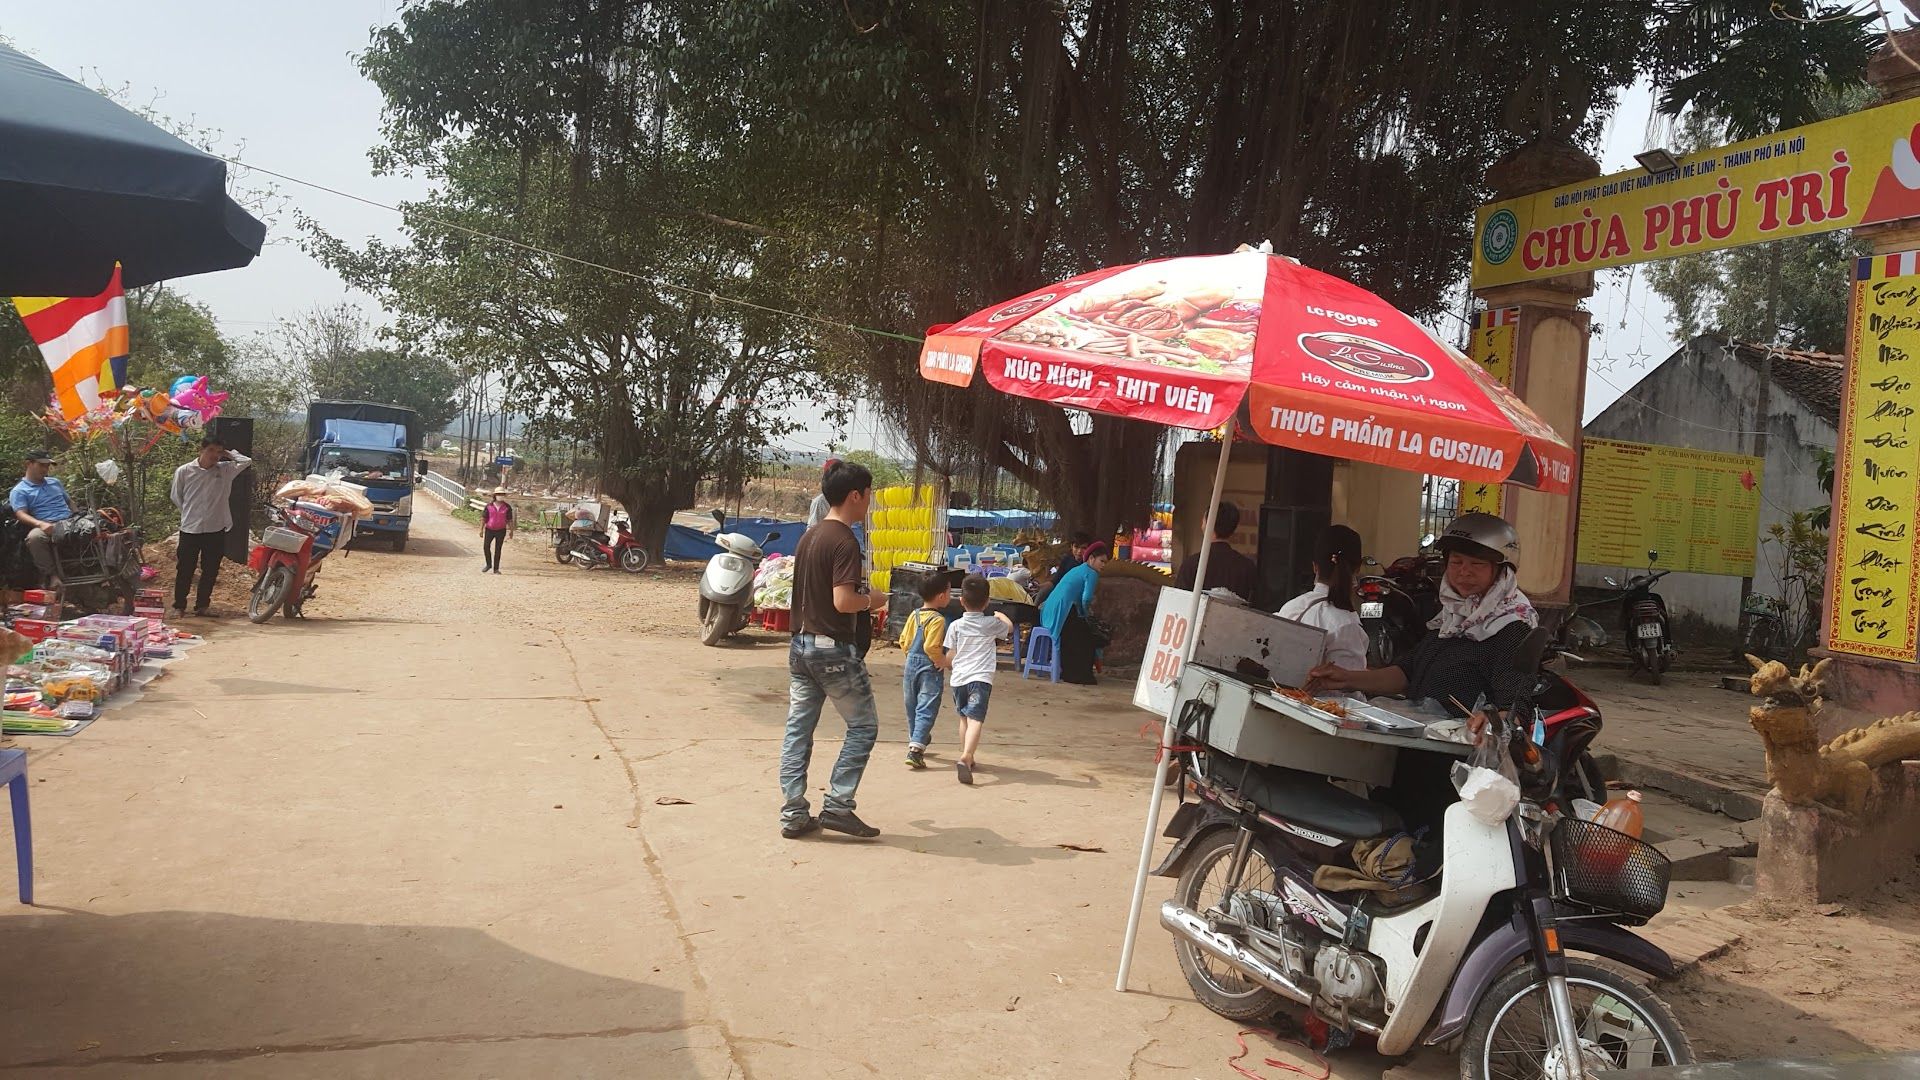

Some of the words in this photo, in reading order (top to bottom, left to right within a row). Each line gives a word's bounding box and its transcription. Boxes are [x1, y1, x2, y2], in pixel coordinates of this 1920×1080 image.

[1636, 173, 1653, 189] NAM
[1697, 162, 1716, 175] LINH
[1522, 207, 1632, 271] CHÙA
[1642, 176, 1742, 252] PHÙ
[1754, 149, 1851, 231] TRÌ
[1306, 304, 1324, 317] LC
[1326, 310, 1379, 328] FOODS
[1328, 345, 1351, 361] La
[1353, 351, 1407, 372] Cusina
[1003, 356, 1042, 383] XÚC
[1046, 362, 1094, 390] XÍCH
[1116, 375, 1161, 405] THỊT
[1164, 385, 1215, 414] VIÊN
[1301, 371, 1331, 387] Hãy
[1334, 379, 1367, 393] cảm
[1370, 385, 1409, 401] nhận
[1411, 393, 1426, 406] vị
[1429, 398, 1467, 412] ngon
[1270, 406, 1325, 438] THỰC
[1330, 414, 1393, 449] PHẨM
[1398, 430, 1423, 455] LA
[1429, 436, 1505, 471] CUSINA
[1294, 826, 1328, 842] HONDA
